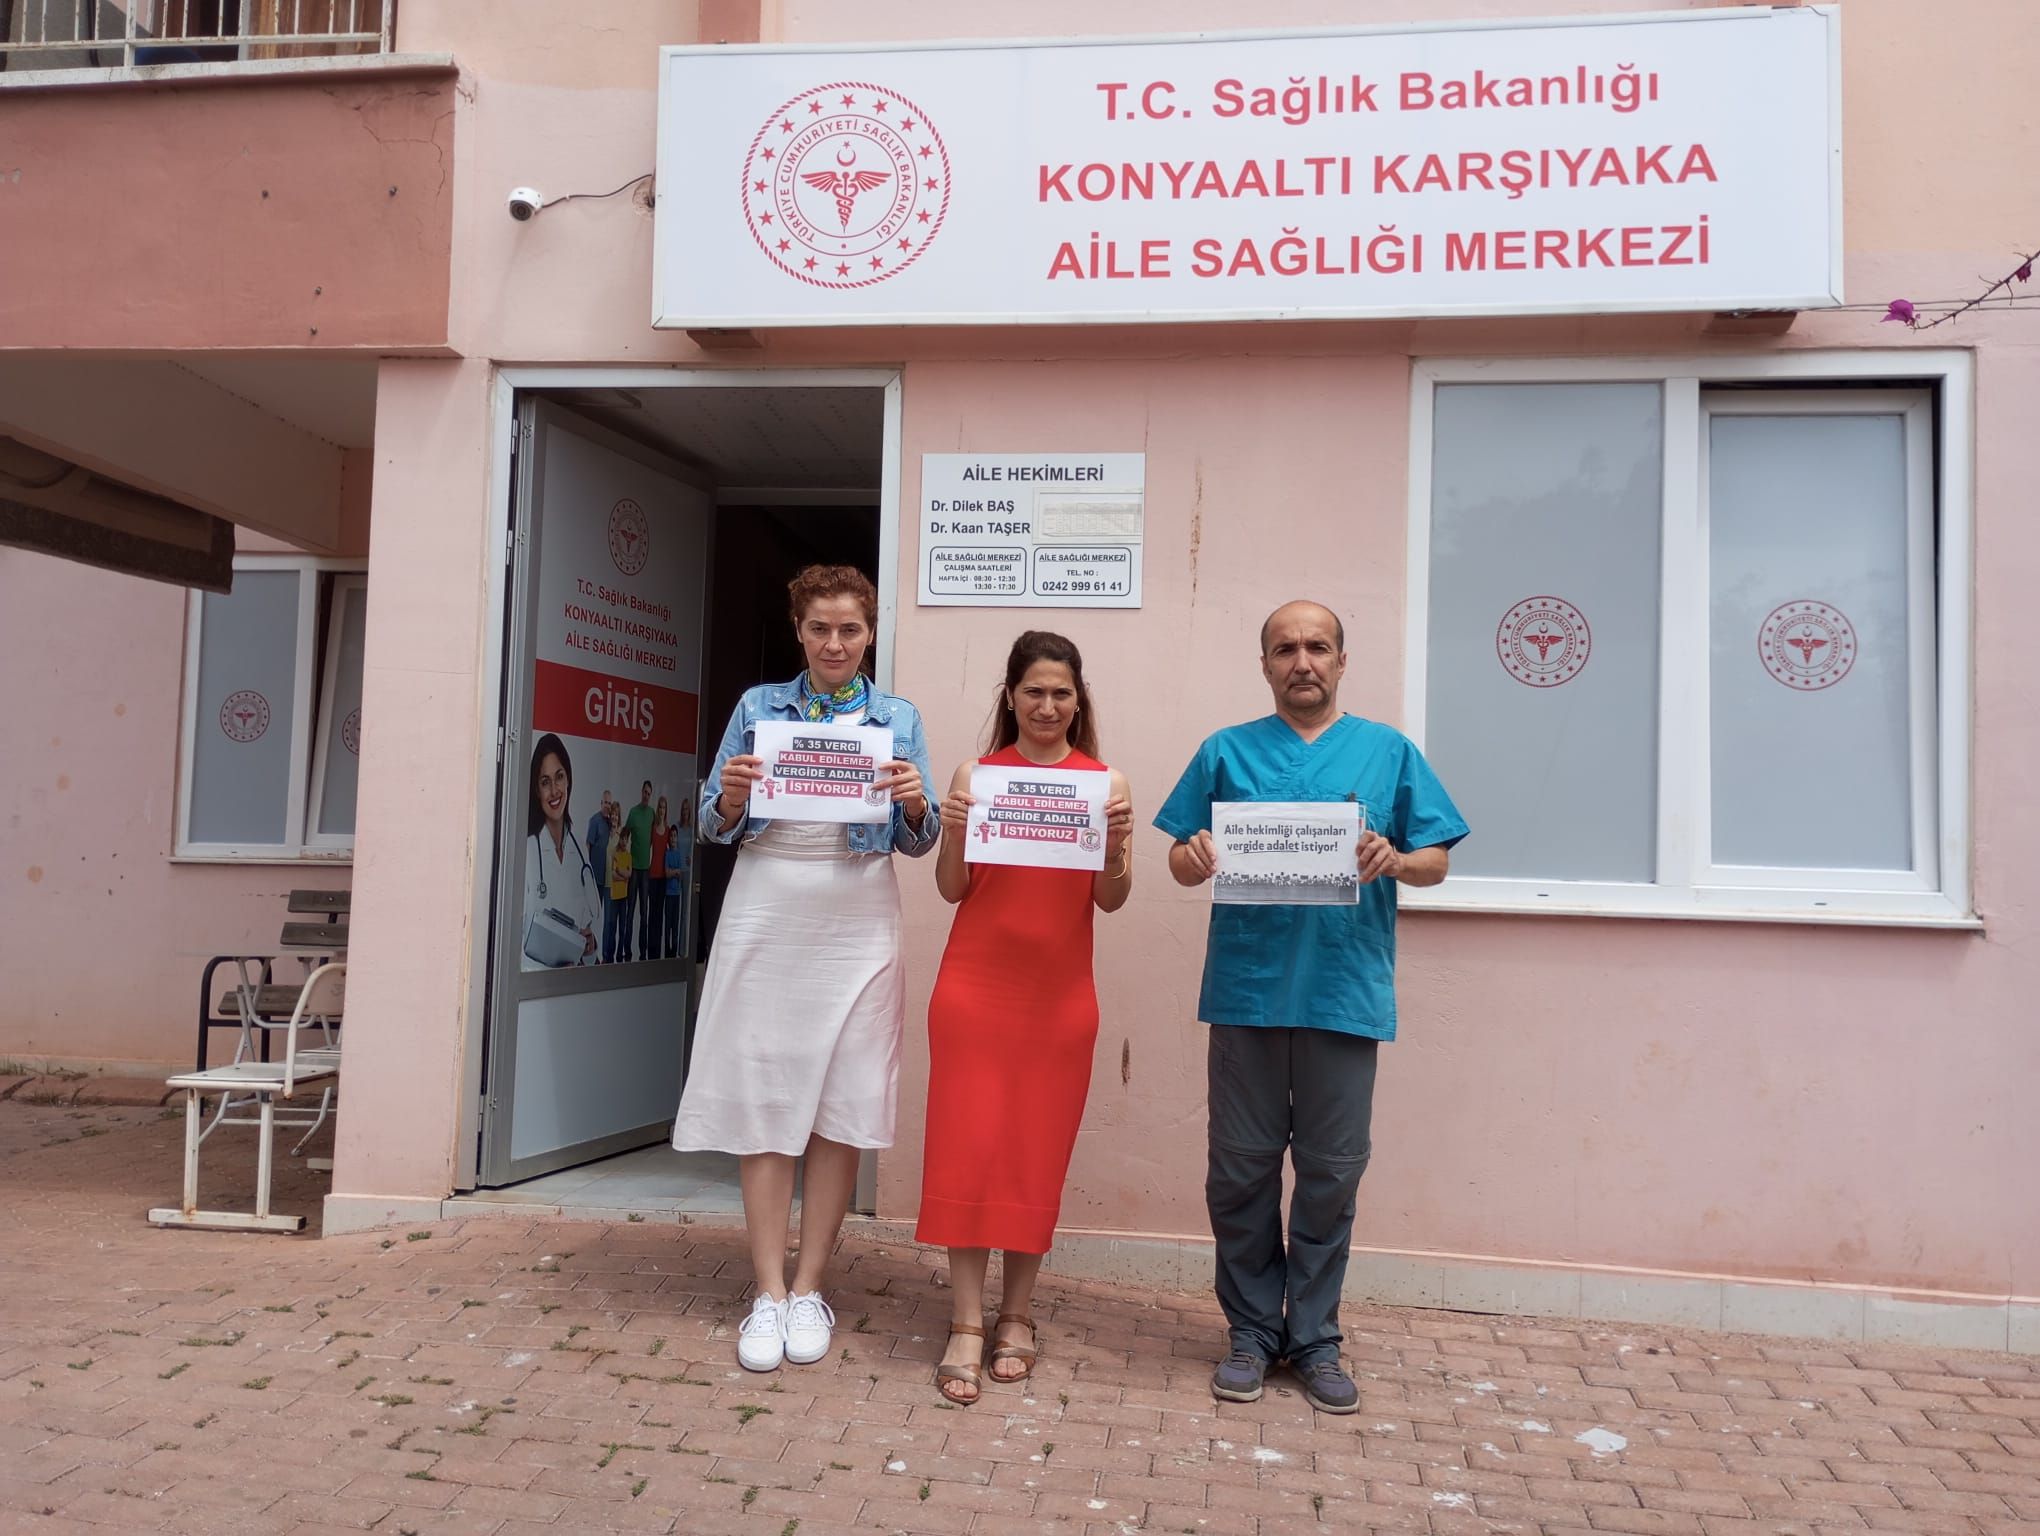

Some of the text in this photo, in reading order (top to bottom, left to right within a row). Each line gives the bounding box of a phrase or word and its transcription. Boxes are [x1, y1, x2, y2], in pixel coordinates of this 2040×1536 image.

[1096, 62, 1658, 125] T.C. Sağlık Bakanlığı
[1038, 143, 1719, 202] KONYAALTI KARŞIYAKA
[780, 119, 911, 243] TÜRKİYE CUMHURİYETİ SAĞLIK BAKANLIĞI
[1047, 214, 1709, 280] AİLE SAĞLIĞI MERKEZİ
[962, 464, 1104, 481] AİLE HEKİMLERİ
[931, 500, 1015, 515] Dr. Dilek BAŞ
[931, 522, 1031, 537] Dr. Kaan TAŞER
[935, 552, 1021, 561] AİLE SAĞLIĞI MERKEZİ
[1039, 553, 1126, 561] AİLE SAĞLIĞI MERKEZİ
[944, 564, 1012, 572] ÇALIŞMA SAATLERİ
[1042, 582, 1122, 591] 0242 999 61 41
[577, 579, 671, 621] T.C. Sağlık Bakanlığı
[564, 603, 678, 648] KONYAALTI KARŞIYAKA
[565, 630, 676, 672] AİLE SAĞLIĞI MERKEZİ
[584, 681, 654, 740] GİRİŞ
[794, 739, 859, 752] % 35 VERGİ
[780, 754, 872, 766] KABUL EDİLEMEZ
[774, 766, 873, 780] VERGİDE ADALET
[790, 781, 858, 795] İSTİYORUZ
[1010, 783, 1075, 796] % 35 VERGİ
[995, 797, 1087, 811] KABUL EDİLEMEZ
[989, 810, 1089, 825] VERGİDE ADALET
[1005, 826, 1074, 840] İSTİYORUZ
[1224, 824, 1346, 838] Aile hekimliği çalışanları
[1227, 840, 1338, 854] vergide adalet istiyor!
